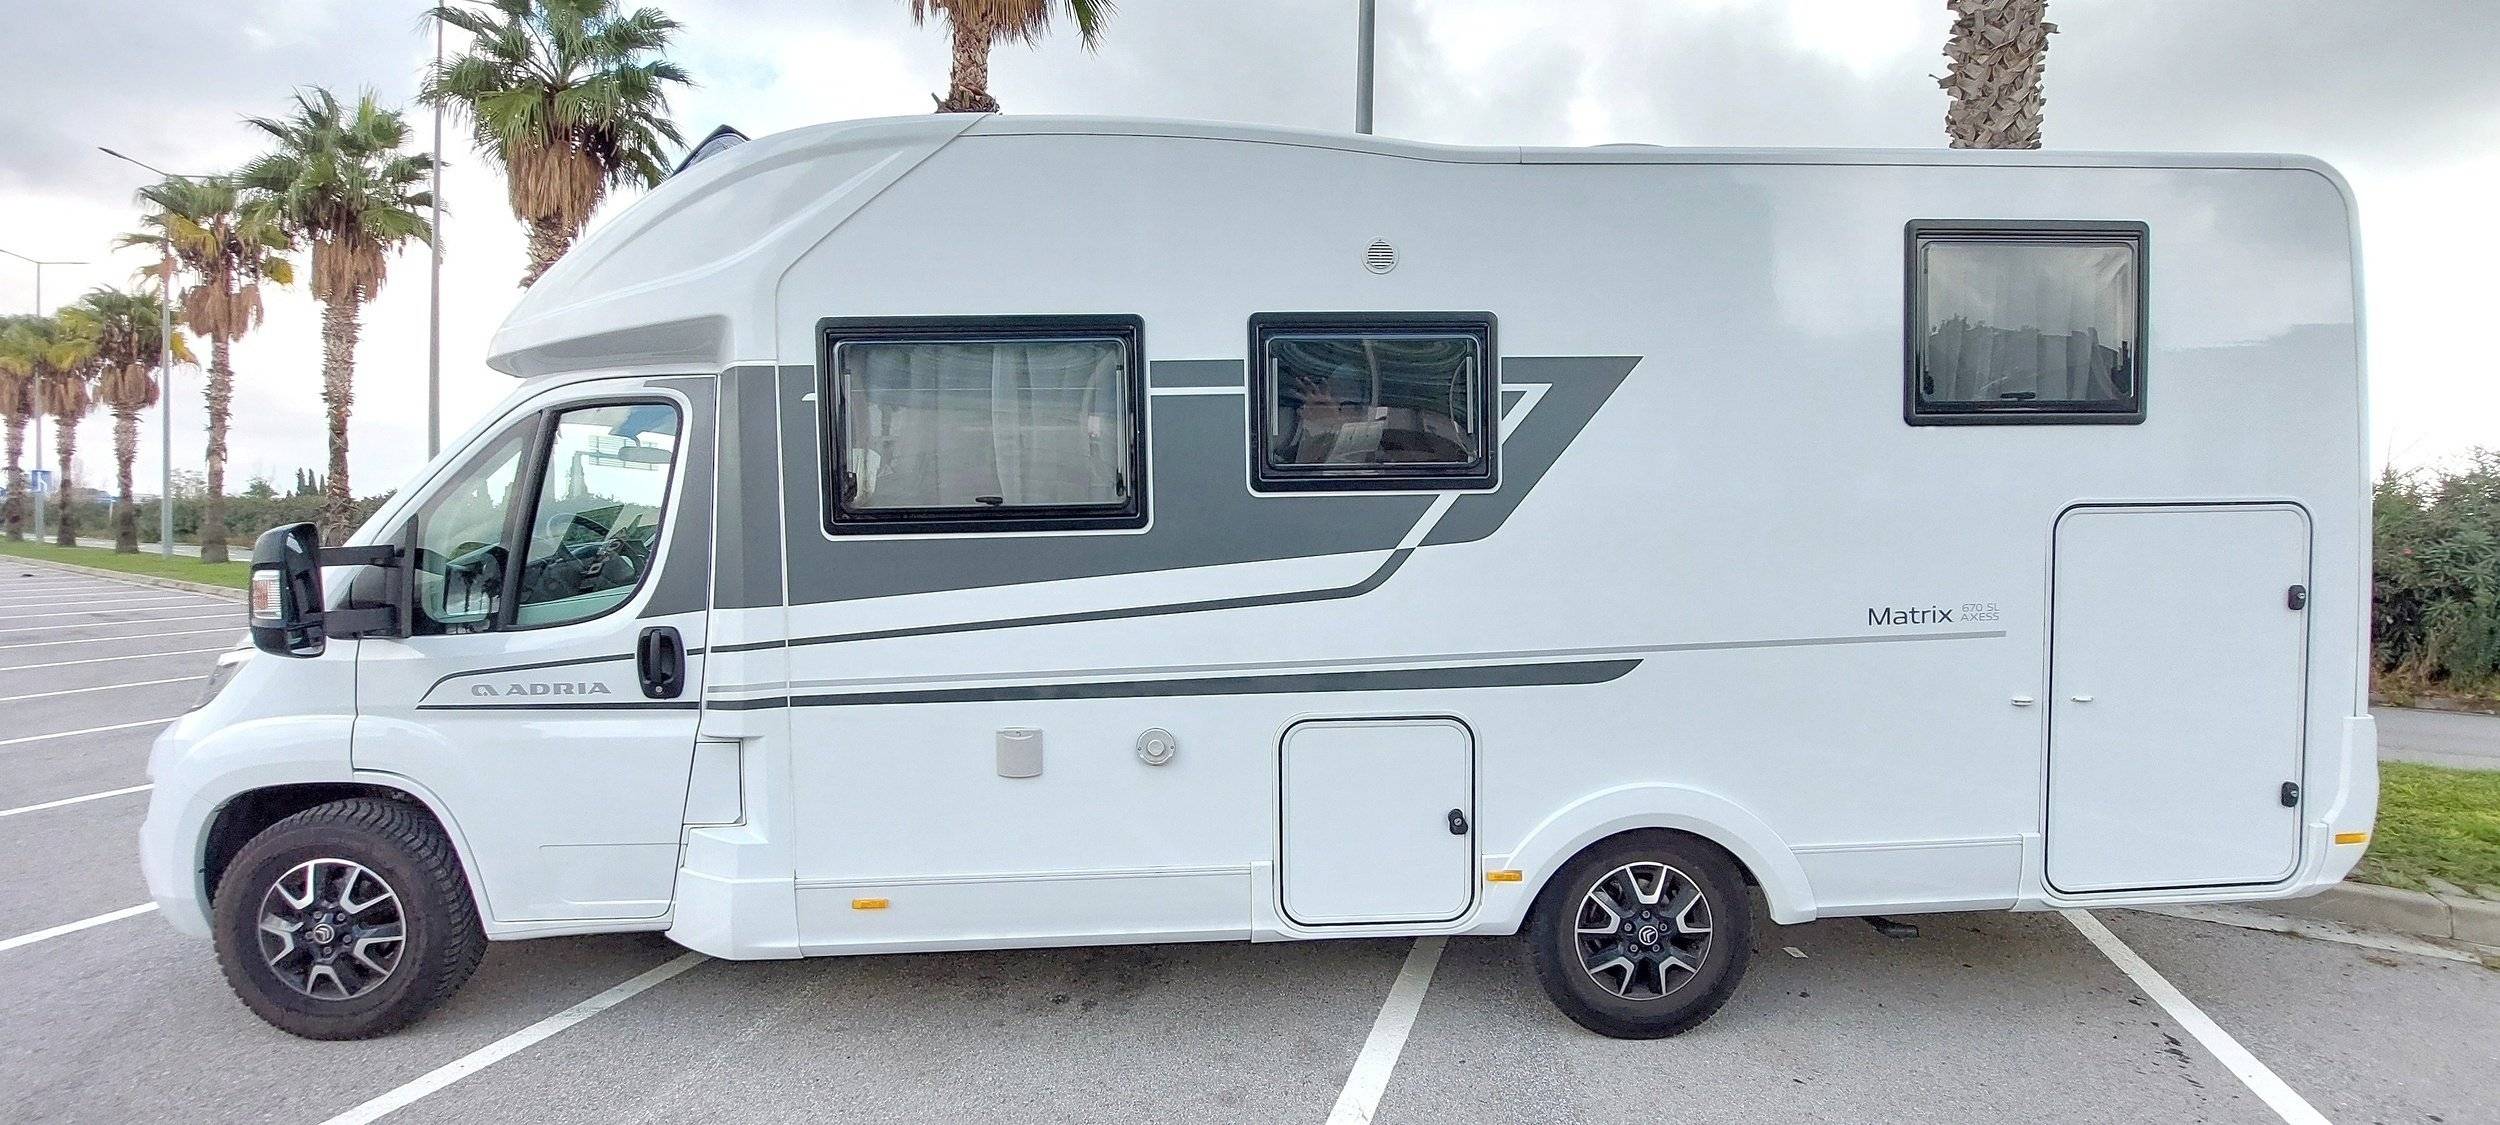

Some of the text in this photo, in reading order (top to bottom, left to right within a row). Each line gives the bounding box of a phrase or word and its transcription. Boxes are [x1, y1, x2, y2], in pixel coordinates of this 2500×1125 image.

[1961, 602, 2000, 612] 670 SL
[1868, 605, 1953, 626] Matrix
[1960, 612, 2000, 622] AXESS
[505, 682, 612, 696] ADRIA
